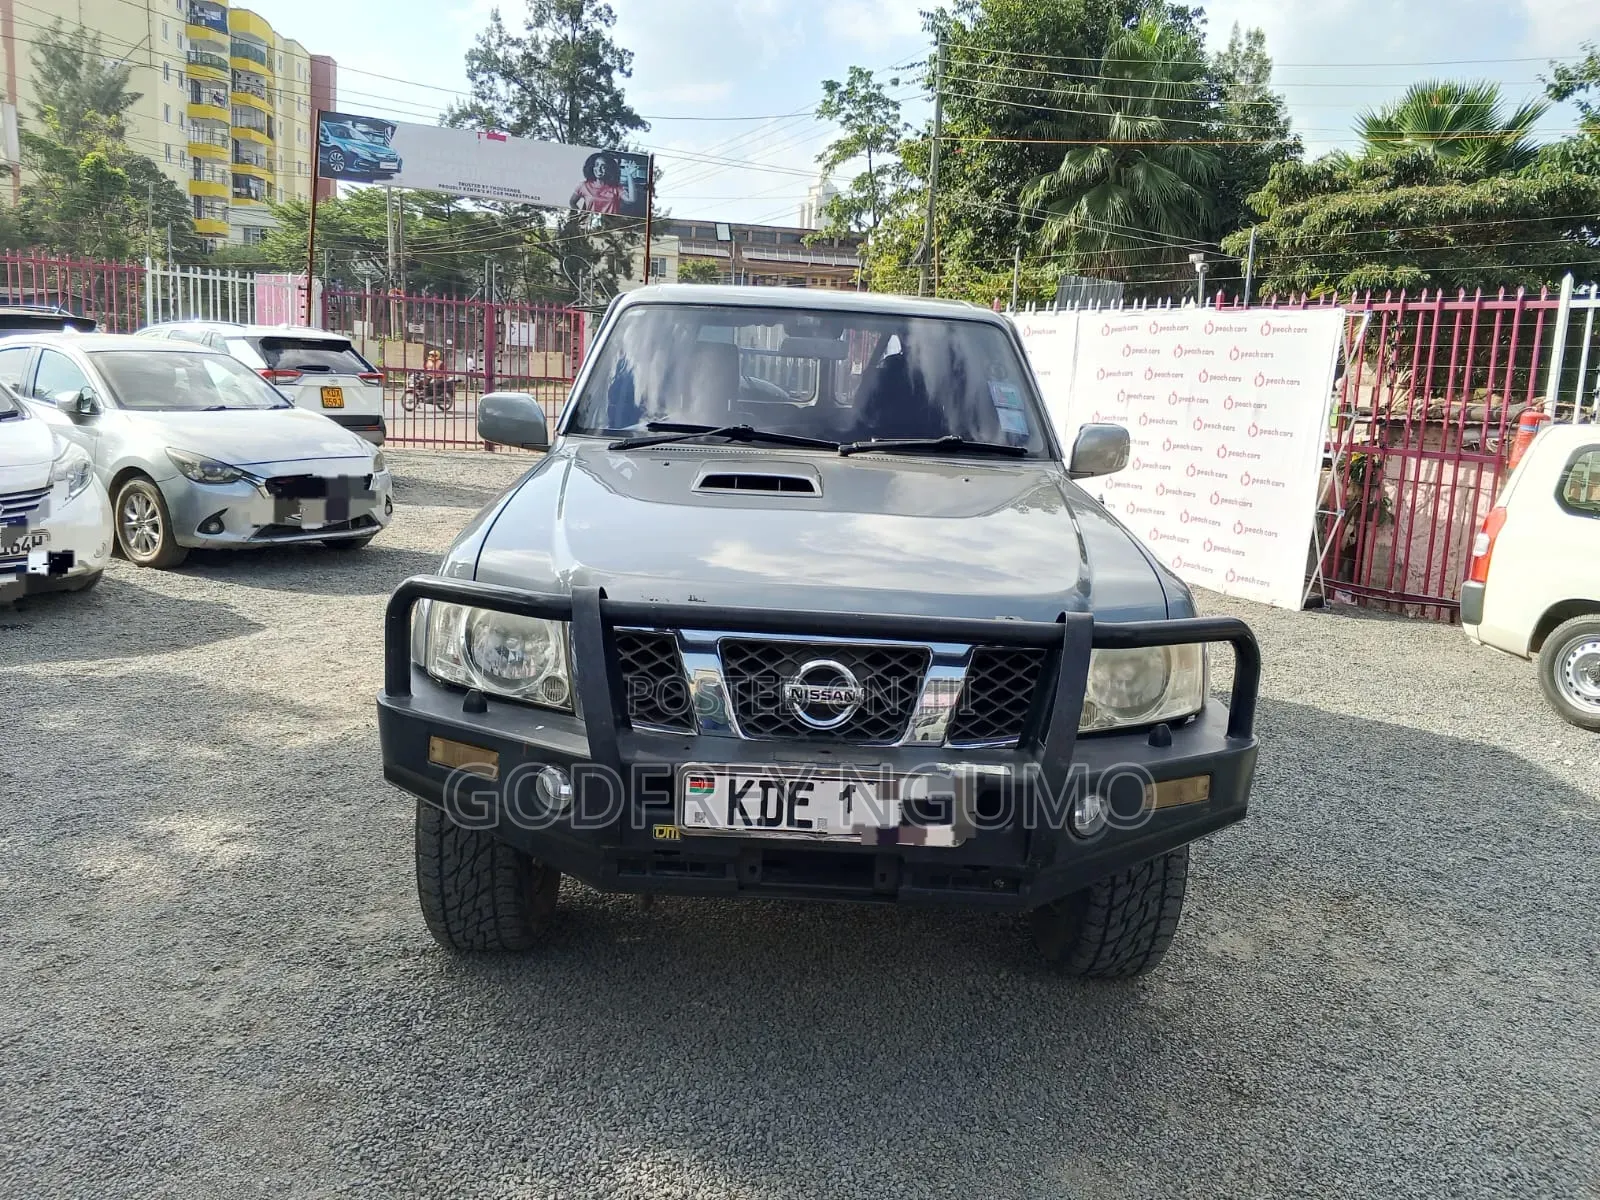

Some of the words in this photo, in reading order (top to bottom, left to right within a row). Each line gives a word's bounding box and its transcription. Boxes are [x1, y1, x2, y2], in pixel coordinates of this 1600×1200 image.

[438, 183, 462, 191] PROUDLY
[505, 192, 541, 200] MARKETPLACE
[458, 181, 481, 189] TRUSTED
[791, 688, 857, 702] NISSAN
[727, 778, 815, 829] KDE
